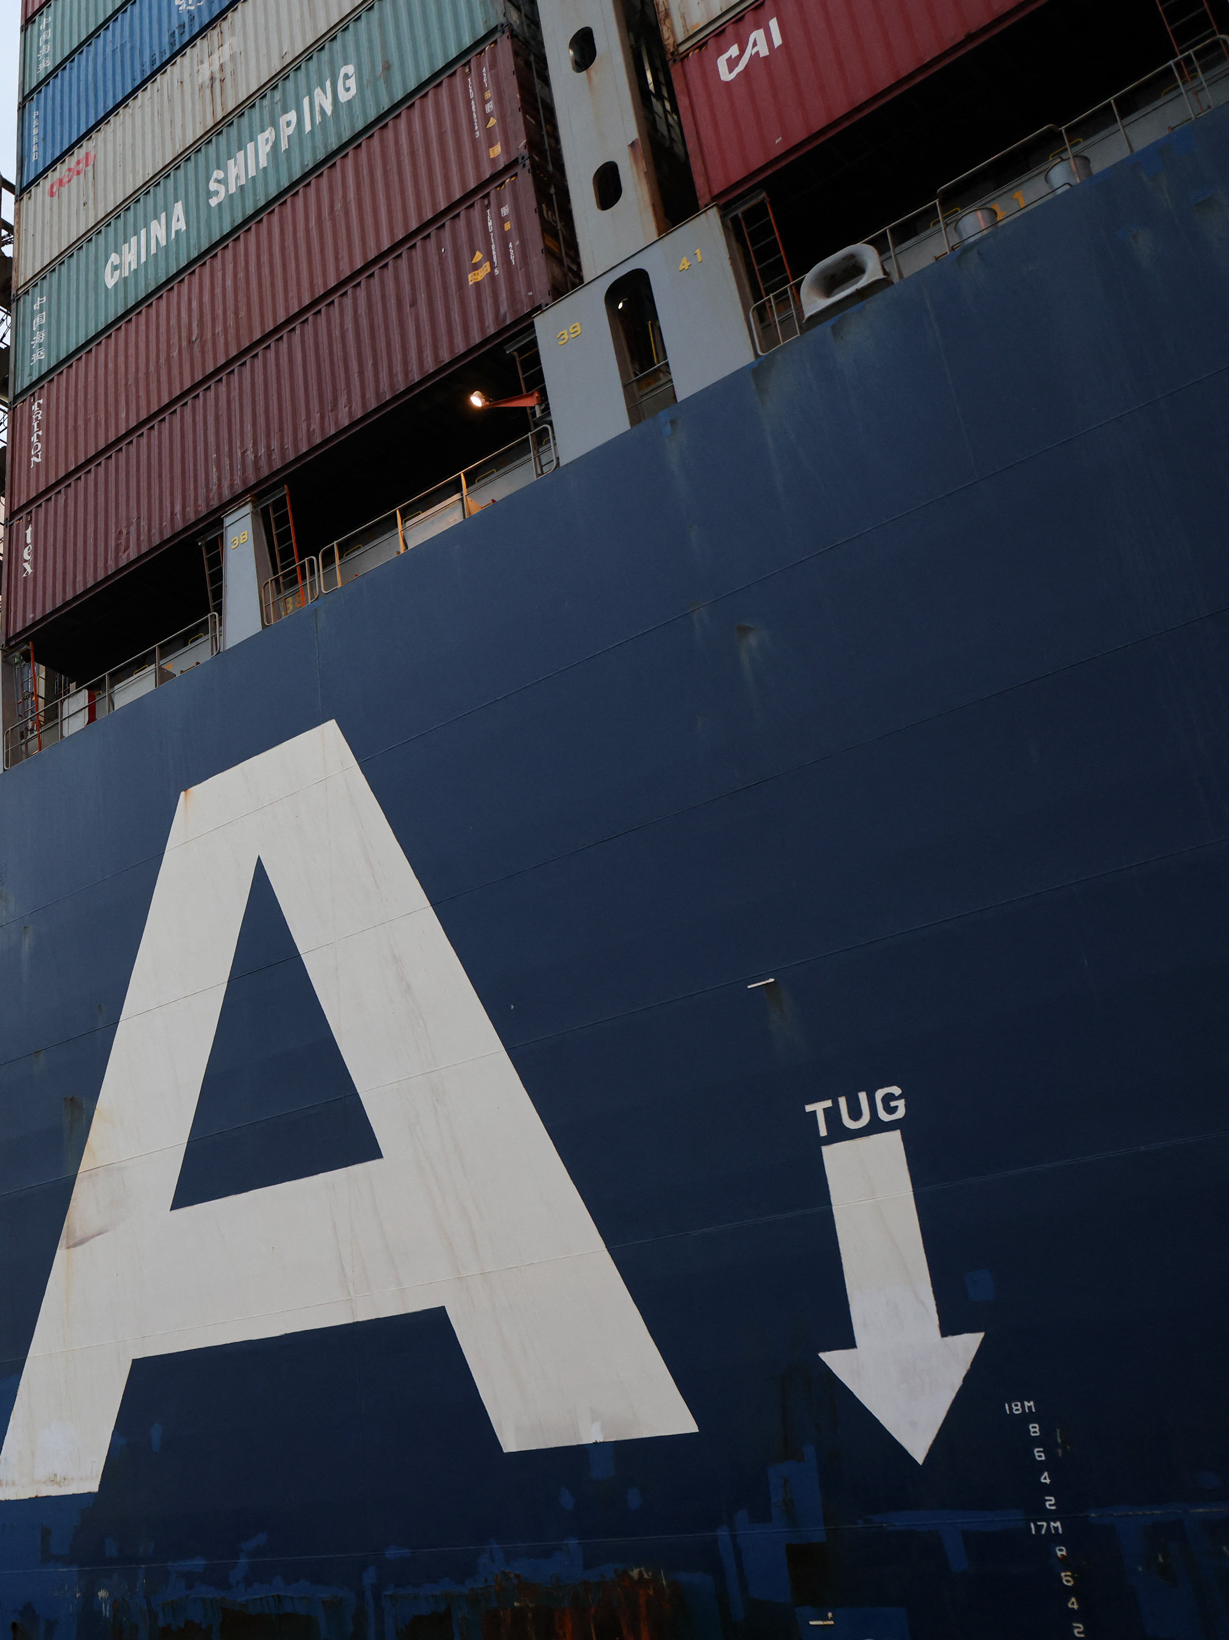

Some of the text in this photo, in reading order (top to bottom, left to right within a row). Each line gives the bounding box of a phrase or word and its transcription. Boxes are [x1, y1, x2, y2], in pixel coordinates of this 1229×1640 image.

[716, 16, 783, 82] CAI
[104, 63, 357, 289] CHINA SHIPPING
[678, 247, 703, 273] 41
[556, 321, 582, 346] 39
[30, 398, 44, 469] TRITON
[230, 530, 249, 549] 38
[22, 523, 33, 578] tex
[804, 1085, 906, 1137] TUG
[1004, 1400, 1036, 1415] 18M
[1028, 1423, 1040, 1437] 8
[1033, 1448, 1046, 1461] 6
[1040, 1471, 1051, 1484] 4
[1044, 1496, 1056, 1510] 2
[1030, 1520, 1063, 1535] 17M
[1060, 1571, 1074, 1587] 6
[1068, 1596, 1079, 1610] 4
[1072, 1622, 1085, 1638] 2
